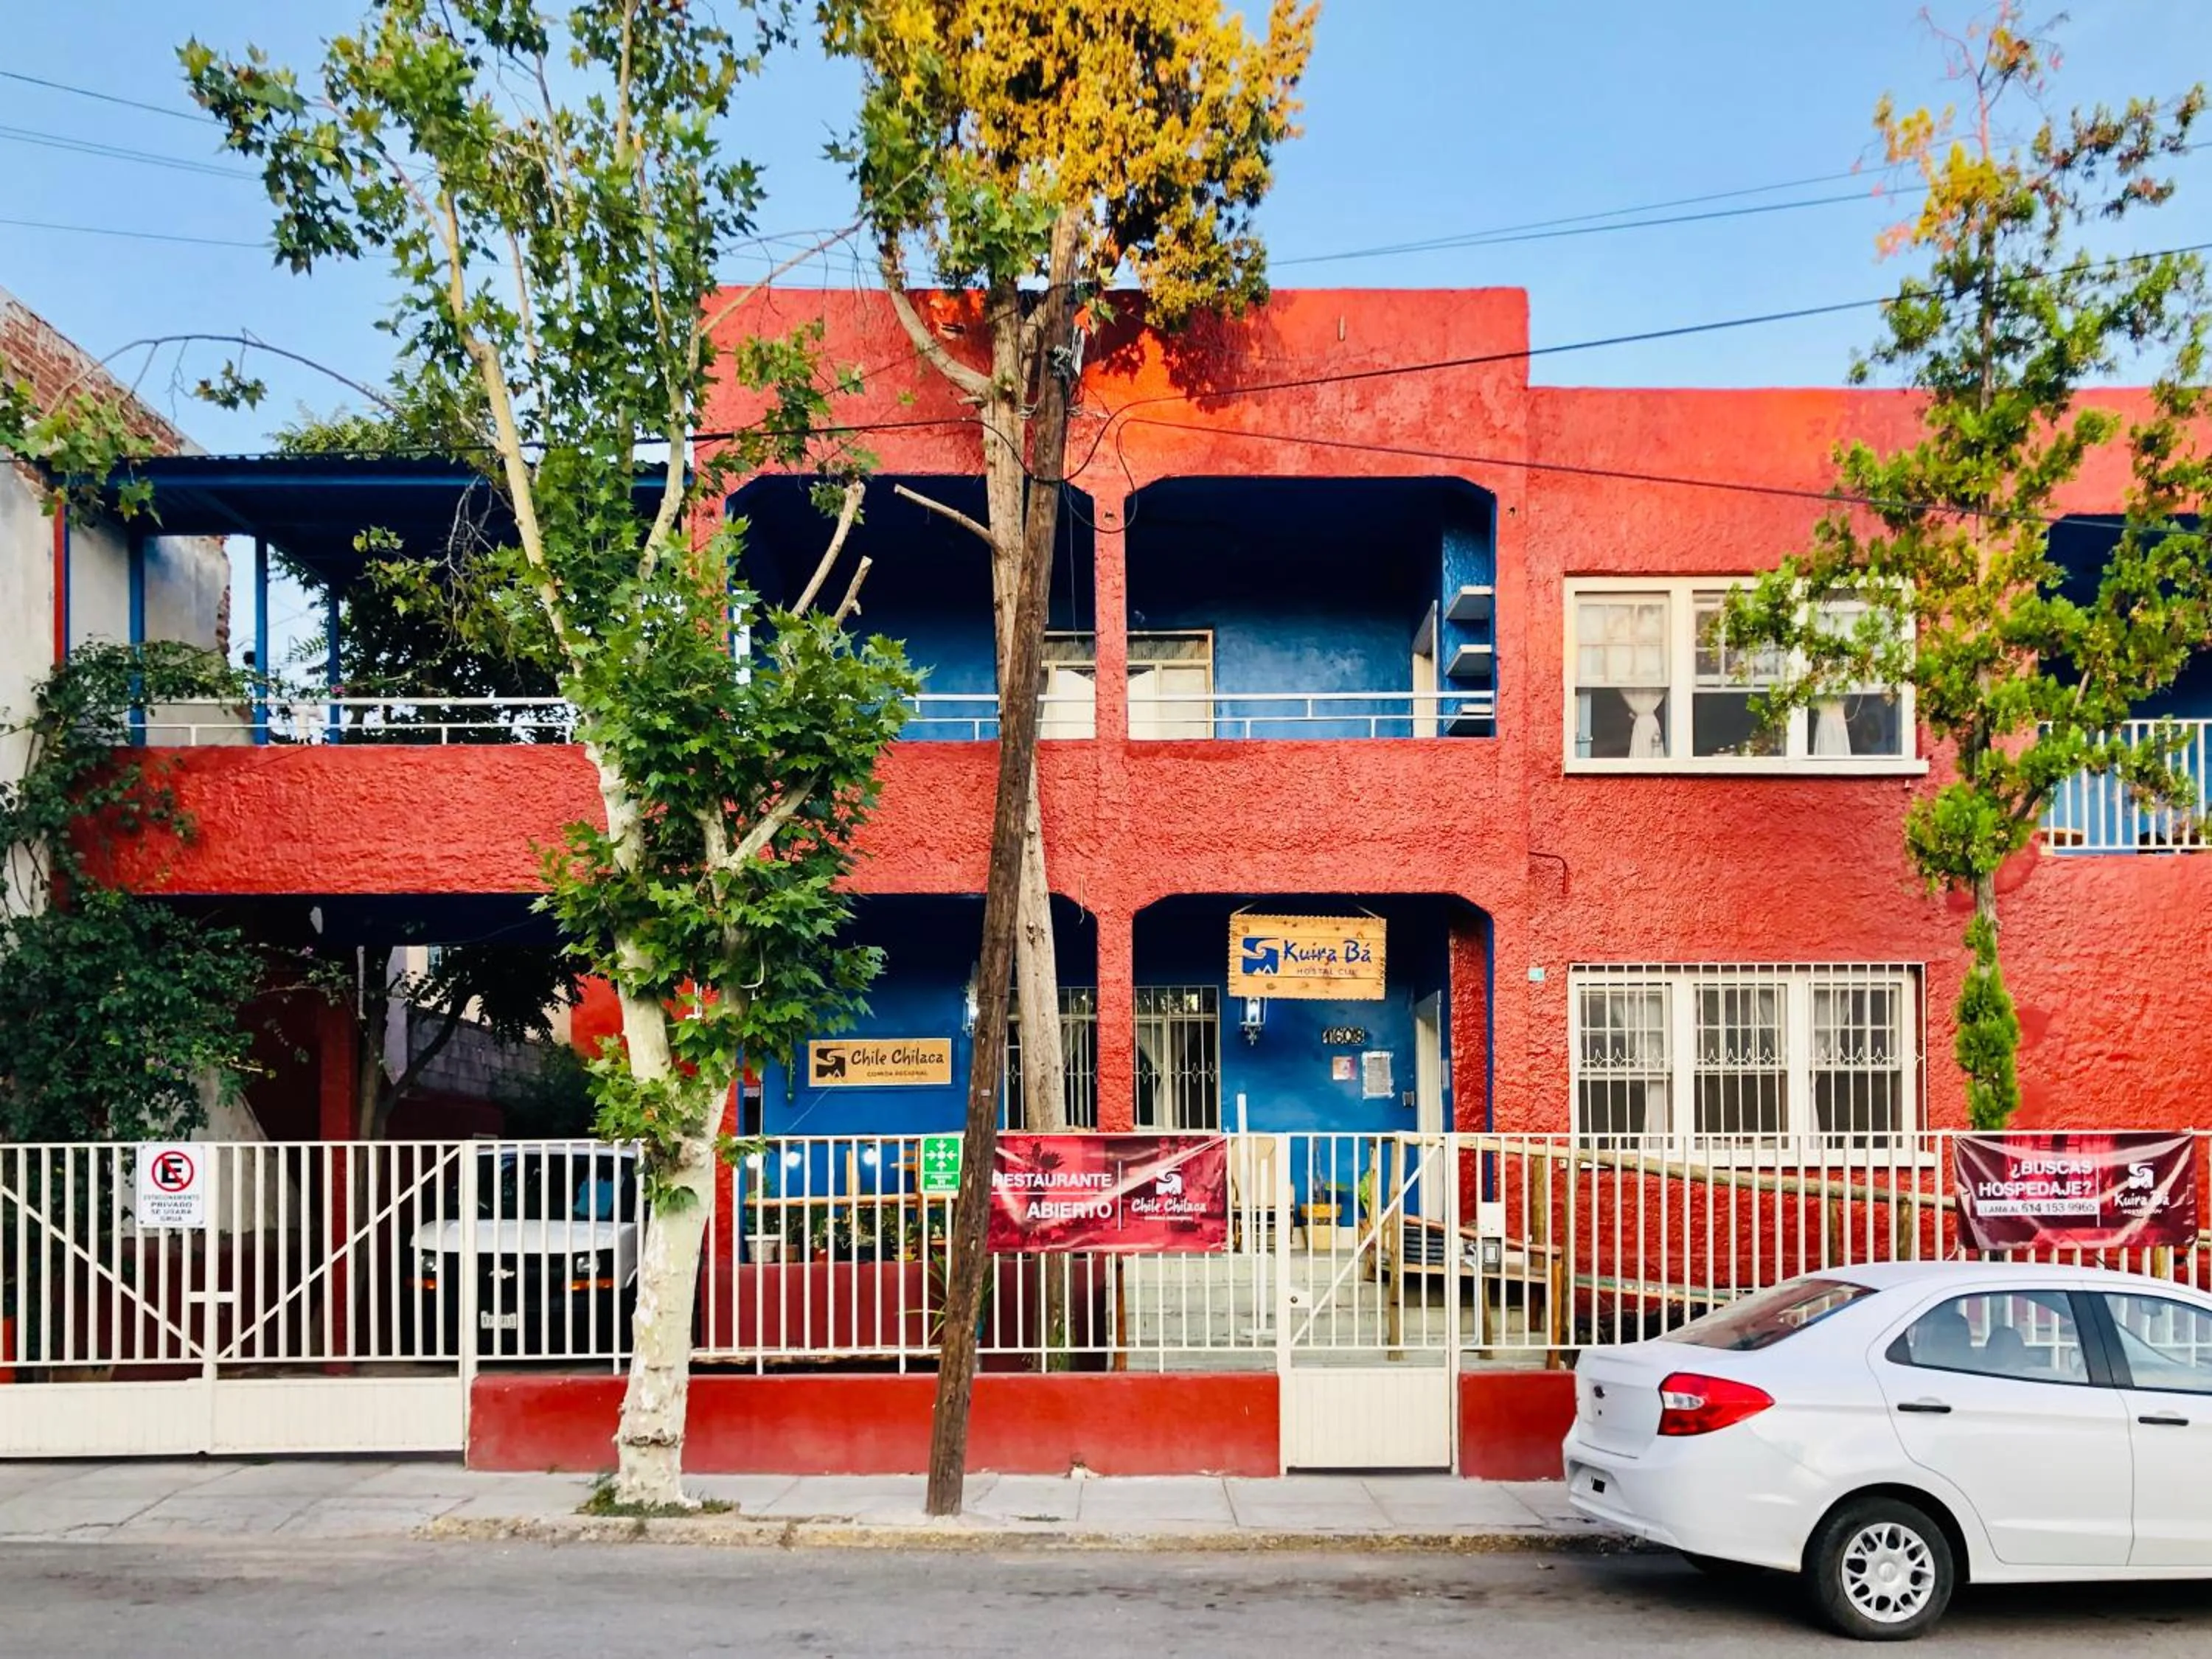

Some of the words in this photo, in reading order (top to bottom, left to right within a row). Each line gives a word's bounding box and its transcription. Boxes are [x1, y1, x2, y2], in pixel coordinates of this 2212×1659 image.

[1284, 939, 1338, 962] Kuira
[1343, 939, 1371, 963] Bá
[1297, 967, 1333, 975] HOSTAL
[851, 1048, 887, 1065] Chile
[891, 1047, 945, 1065] Chilaca
[2009, 1160, 2093, 1179] ¿BUSCAS
[992, 1172, 1112, 1188] RESTAURANTE
[1978, 1181, 2092, 1197] HOSPEDAJE?
[1131, 1197, 1161, 1213] Chile
[1164, 1197, 1207, 1214] Chilaca
[2114, 1192, 2147, 1207] Kuira
[1026, 1202, 1113, 1219] ABIERTO
